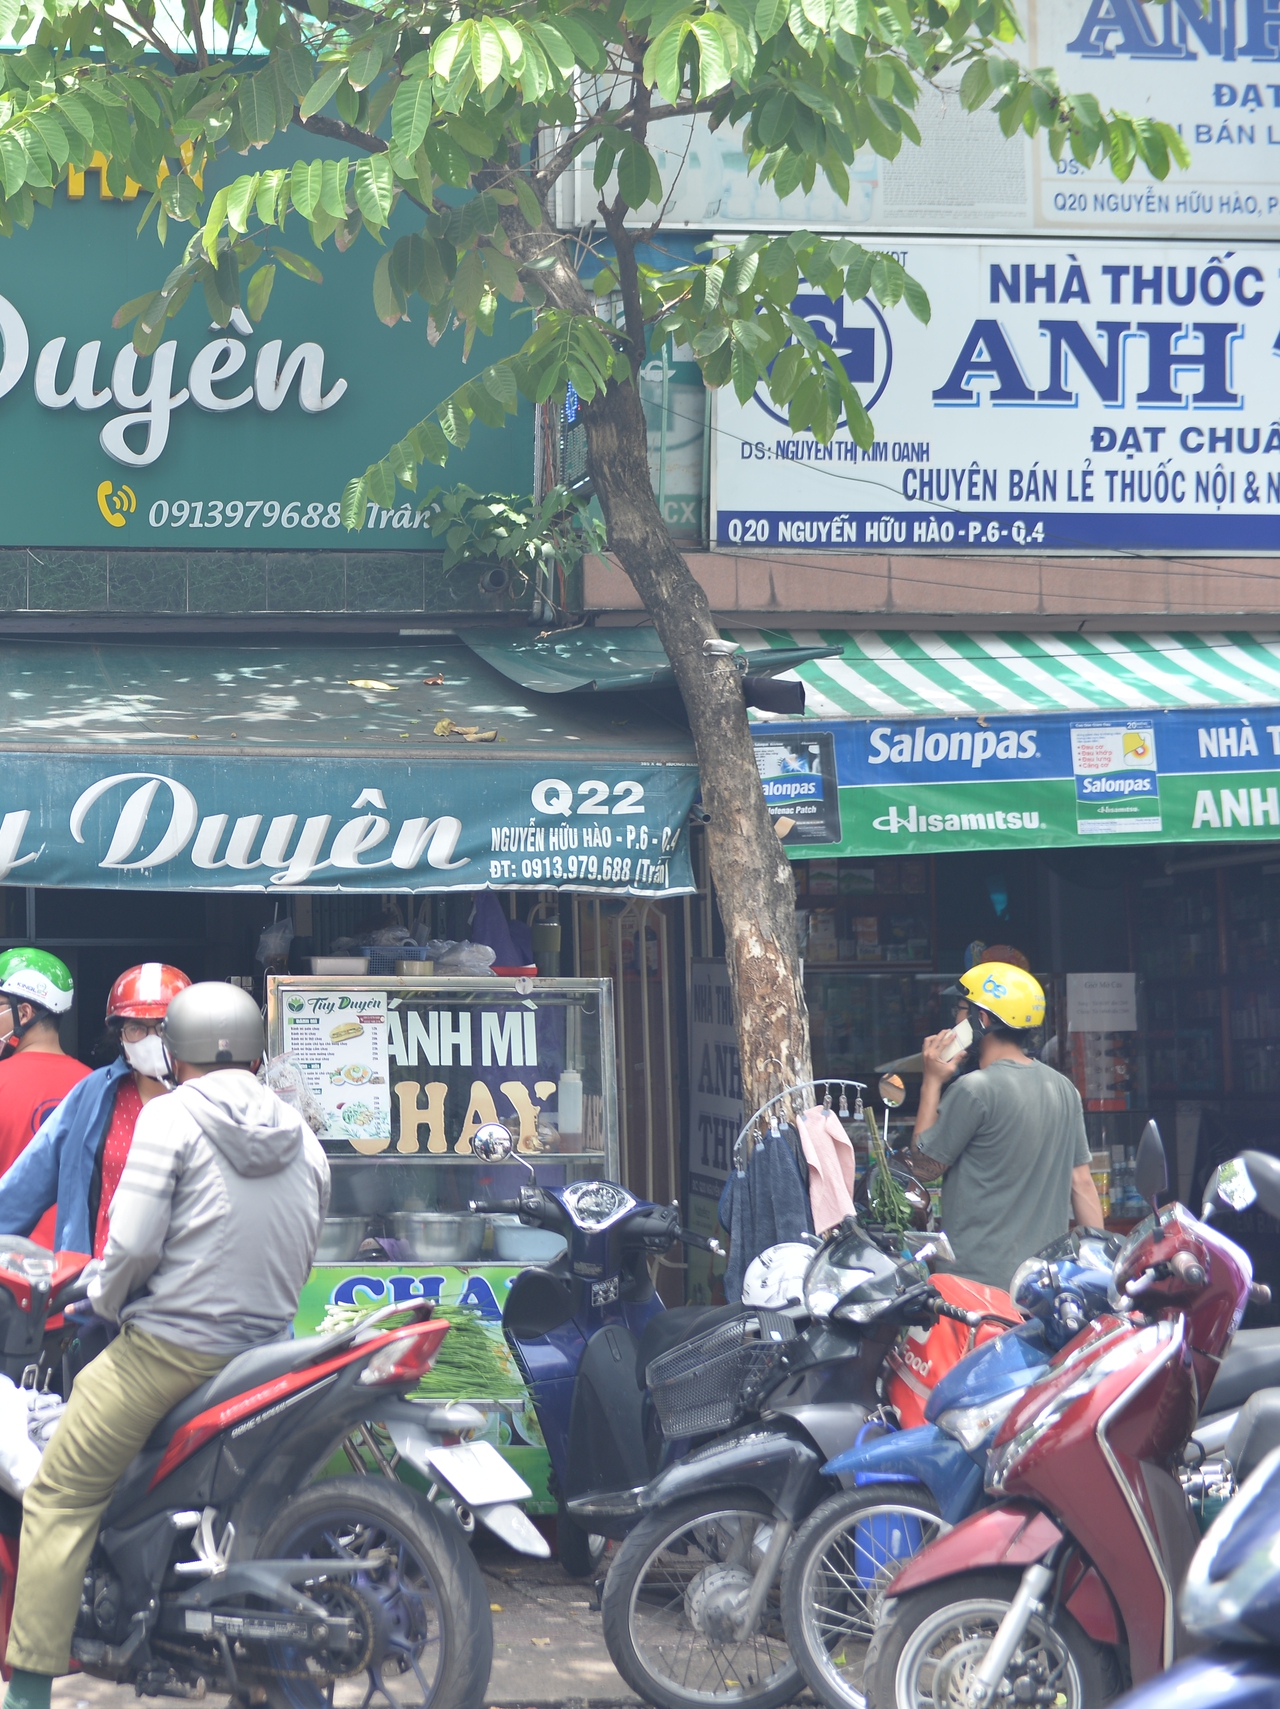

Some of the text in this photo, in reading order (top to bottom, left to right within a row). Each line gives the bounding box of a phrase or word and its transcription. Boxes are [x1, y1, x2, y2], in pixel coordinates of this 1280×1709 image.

[1195, 119, 1256, 145] BÁN
[1054, 192, 1088, 212] Q20
[1093, 185, 1170, 214] NGUYỄN
[1176, 190, 1214, 214] HỮU
[989, 251, 1265, 307] NHÀ THUỐC
[931, 318, 1245, 411] ANH
[740, 441, 772, 460] DS:
[892, 441, 931, 463] OANH
[1091, 426, 1167, 460] ĐẠT
[902, 461, 998, 502] CHUYÊN
[1008, 462, 1058, 502] BÁN
[1068, 458, 1095, 503] LẺ
[1105, 458, 1186, 504] THUỐC
[1194, 463, 1236, 512] NỘI
[1243, 470, 1261, 504] &
[148, 498, 342, 530] 0913979688
[727, 518, 770, 546] Q20
[777, 513, 857, 543] NGUYỄN
[865, 514, 907, 543] HỮU
[867, 725, 1038, 768] Salonpas
[1197, 717, 1260, 759] NHÀ
[531, 778, 646, 818] Q22
[762, 780, 817, 798] alonpas
[1082, 776, 1152, 795] Salonpas
[768, 805, 795, 816] lofenac
[1191, 786, 1280, 829] ANH
[69, 772, 472, 886] Duyên
[490, 816, 545, 852] NGUYỄN
[549, 821, 580, 851] HỮU
[583, 821, 612, 849] HÀO
[626, 824, 649, 850] P.6
[489, 859, 517, 879] ĐT:
[521, 855, 632, 883] 0913.979.688
[694, 974, 714, 1025] NHÀ
[982, 974, 1008, 999] be
[387, 997, 473, 1067] ÁNH
[480, 998, 539, 1067] MÌ
[698, 1038, 743, 1101] ANH
[349, 1080, 558, 1155] HAY
[330, 1275, 516, 1322] CHA
